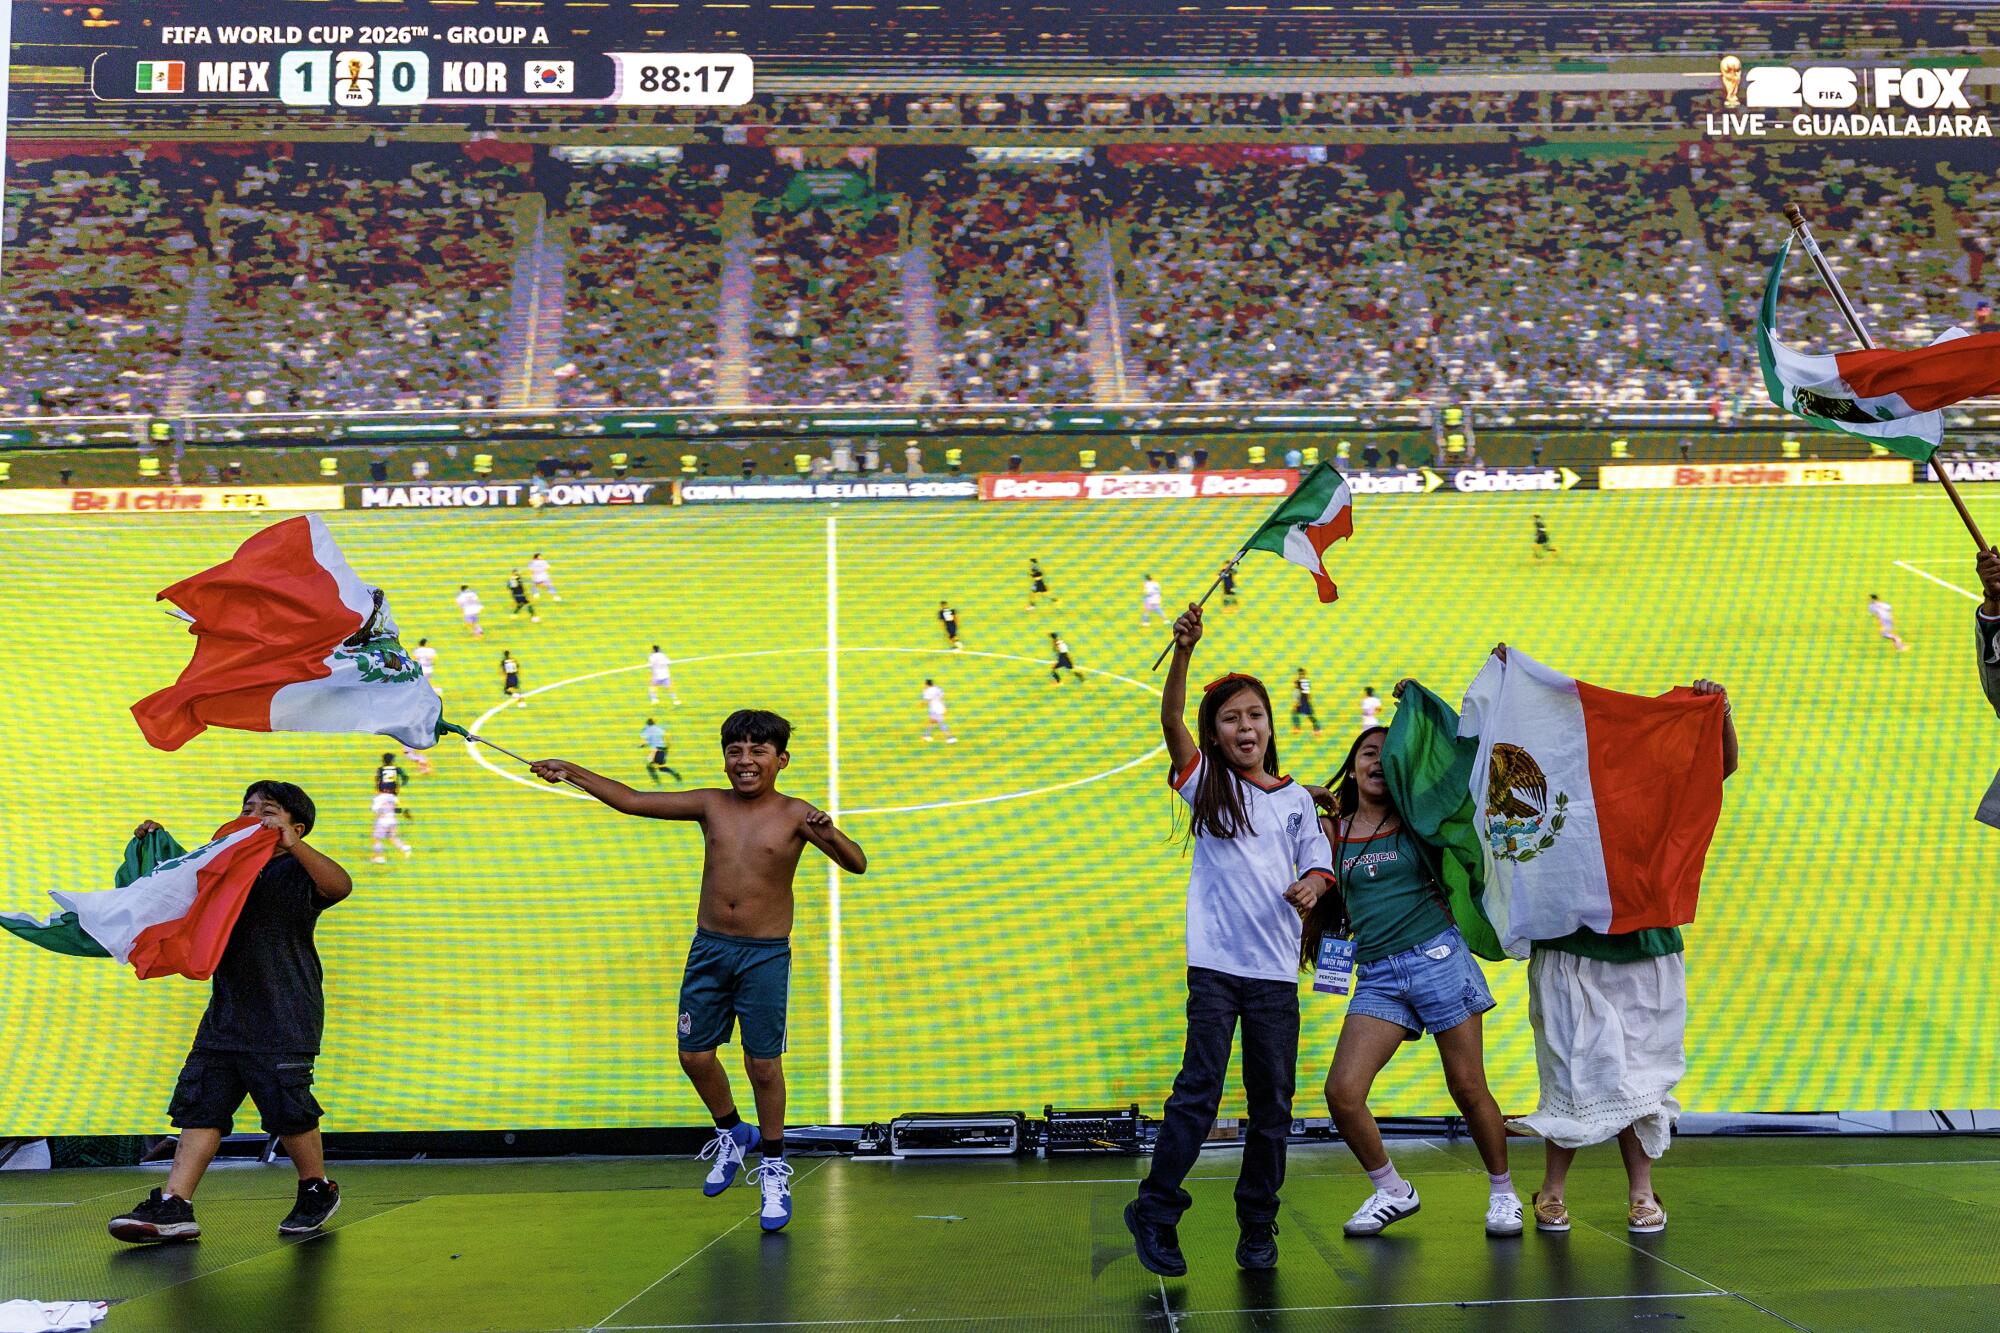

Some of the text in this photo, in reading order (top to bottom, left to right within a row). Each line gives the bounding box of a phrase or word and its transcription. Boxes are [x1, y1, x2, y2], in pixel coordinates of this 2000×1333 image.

[162, 26, 212, 44] FIFA
[217, 26, 302, 44] WORLD
[308, 26, 353, 44] CUP
[447, 26, 526, 44] GROUP
[531, 26, 549, 44] A
[198, 61, 313, 92] MEX 1
[392, 61, 507, 92] 0 KOR
[640, 65, 735, 93] 88:17
[1746, 67, 1971, 108] 26 FOX
[1819, 91, 1843, 100] FIFA
[1706, 114, 1766, 135] LIVE
[1792, 115, 1993, 137] GUADALAJARA
[1340, 470, 1561, 494] obant Globant
[361, 485, 522, 507] MARRIOTT
